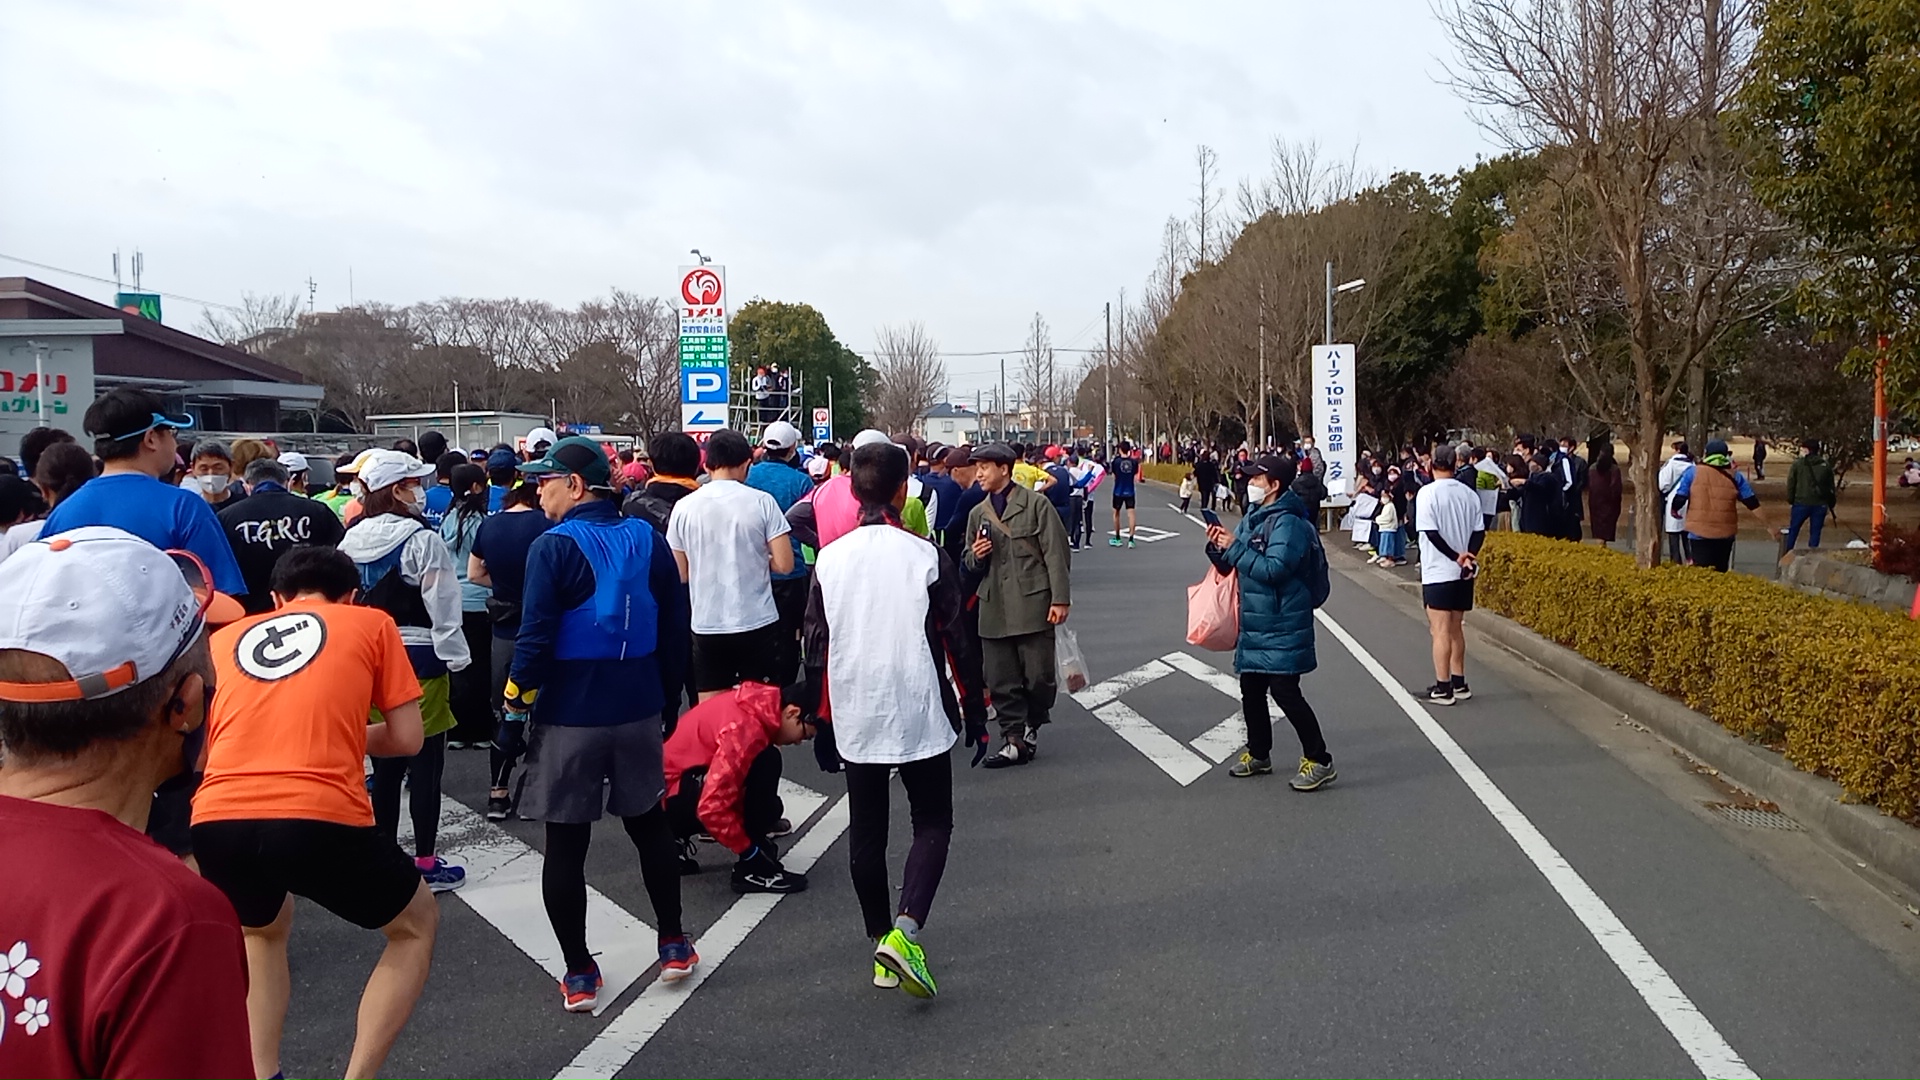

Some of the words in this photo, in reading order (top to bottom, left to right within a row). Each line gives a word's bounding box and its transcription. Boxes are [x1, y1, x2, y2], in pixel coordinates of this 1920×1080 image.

[682, 308, 723, 318] コメリ
[0, 371, 67, 395] コメリ
[688, 373, 722, 401] P
[816, 428, 827, 439] P
[252, 620, 310, 668] ど
